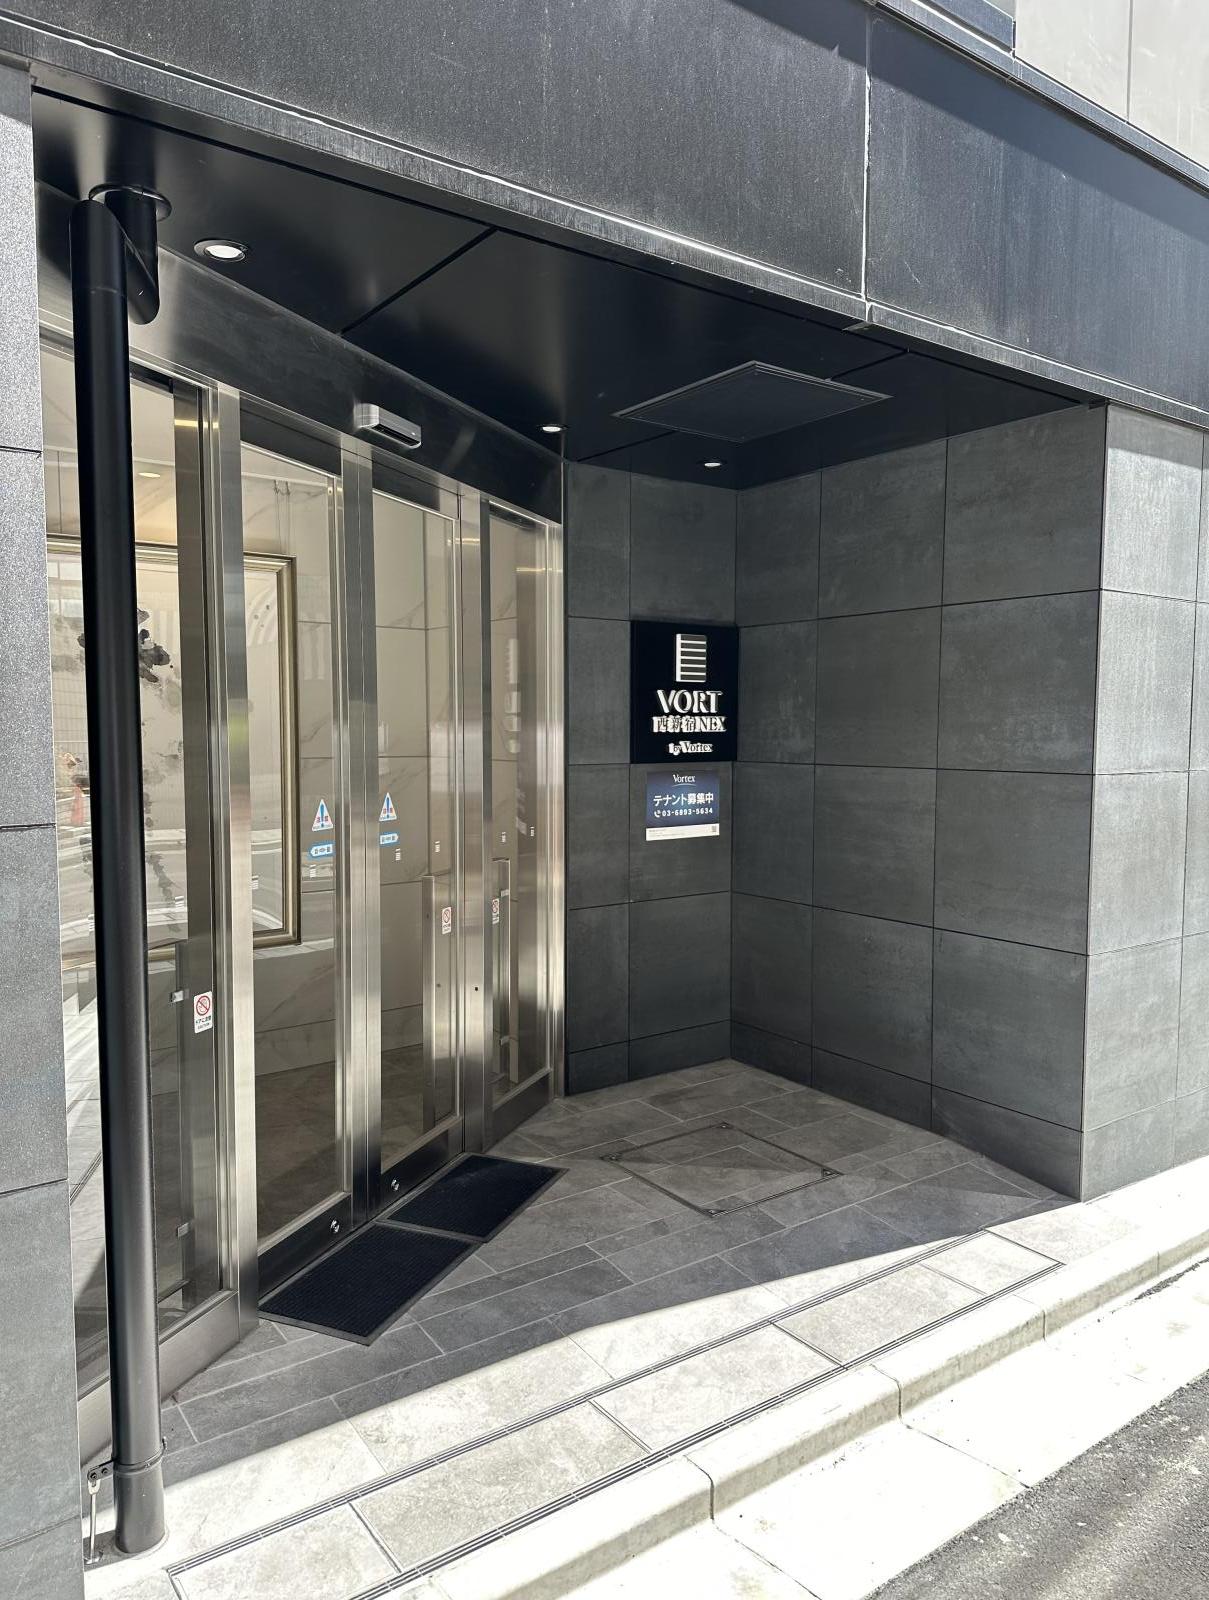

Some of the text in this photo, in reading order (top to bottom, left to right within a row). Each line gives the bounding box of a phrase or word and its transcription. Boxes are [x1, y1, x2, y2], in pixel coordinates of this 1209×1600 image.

[657, 689, 723, 713] VORT
[680, 741, 713, 753] Vortex
[673, 774, 696, 783] Vortex
[653, 792, 714, 807] テナント募集中
